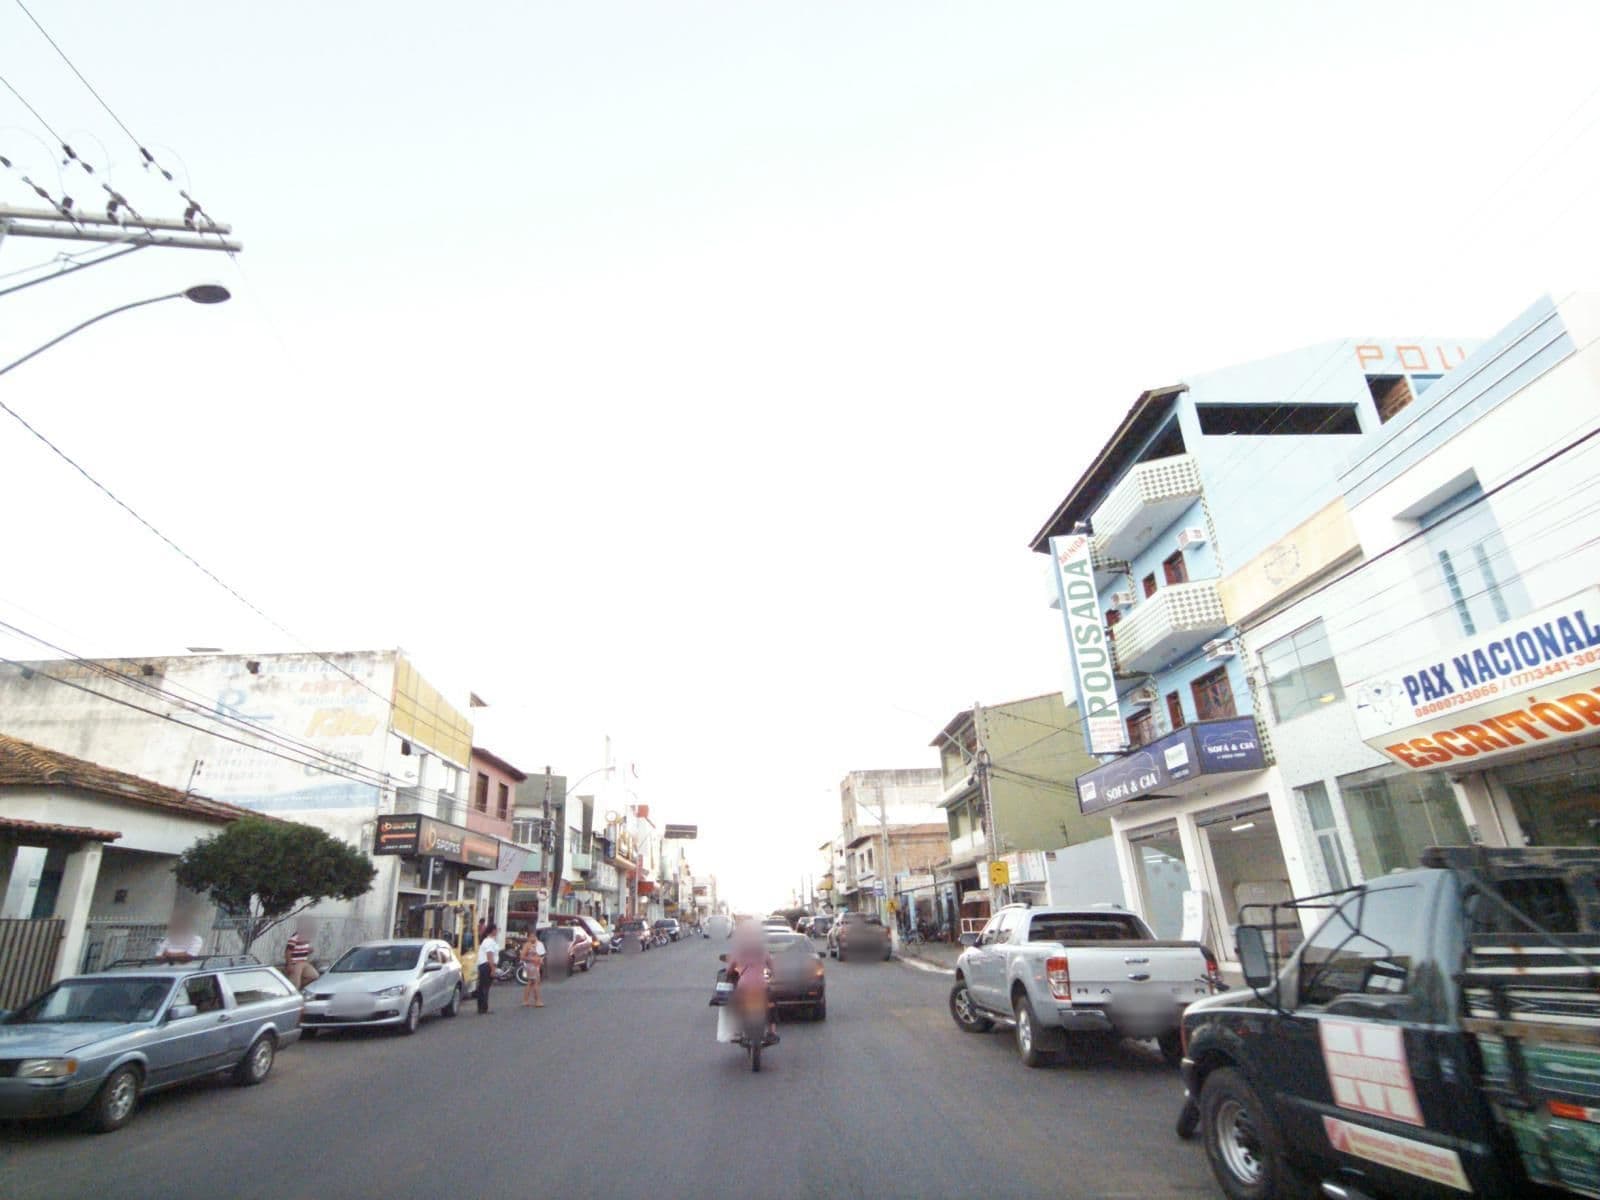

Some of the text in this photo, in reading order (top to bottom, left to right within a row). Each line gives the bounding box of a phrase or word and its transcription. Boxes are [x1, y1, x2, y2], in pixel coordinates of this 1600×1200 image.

[1063, 557, 1118, 719] POUSADA
[1403, 609, 1600, 706] PAX NACIONAL
[1384, 686, 1600, 768] ESCRITÓR
[1130, 779, 1138, 793] &
